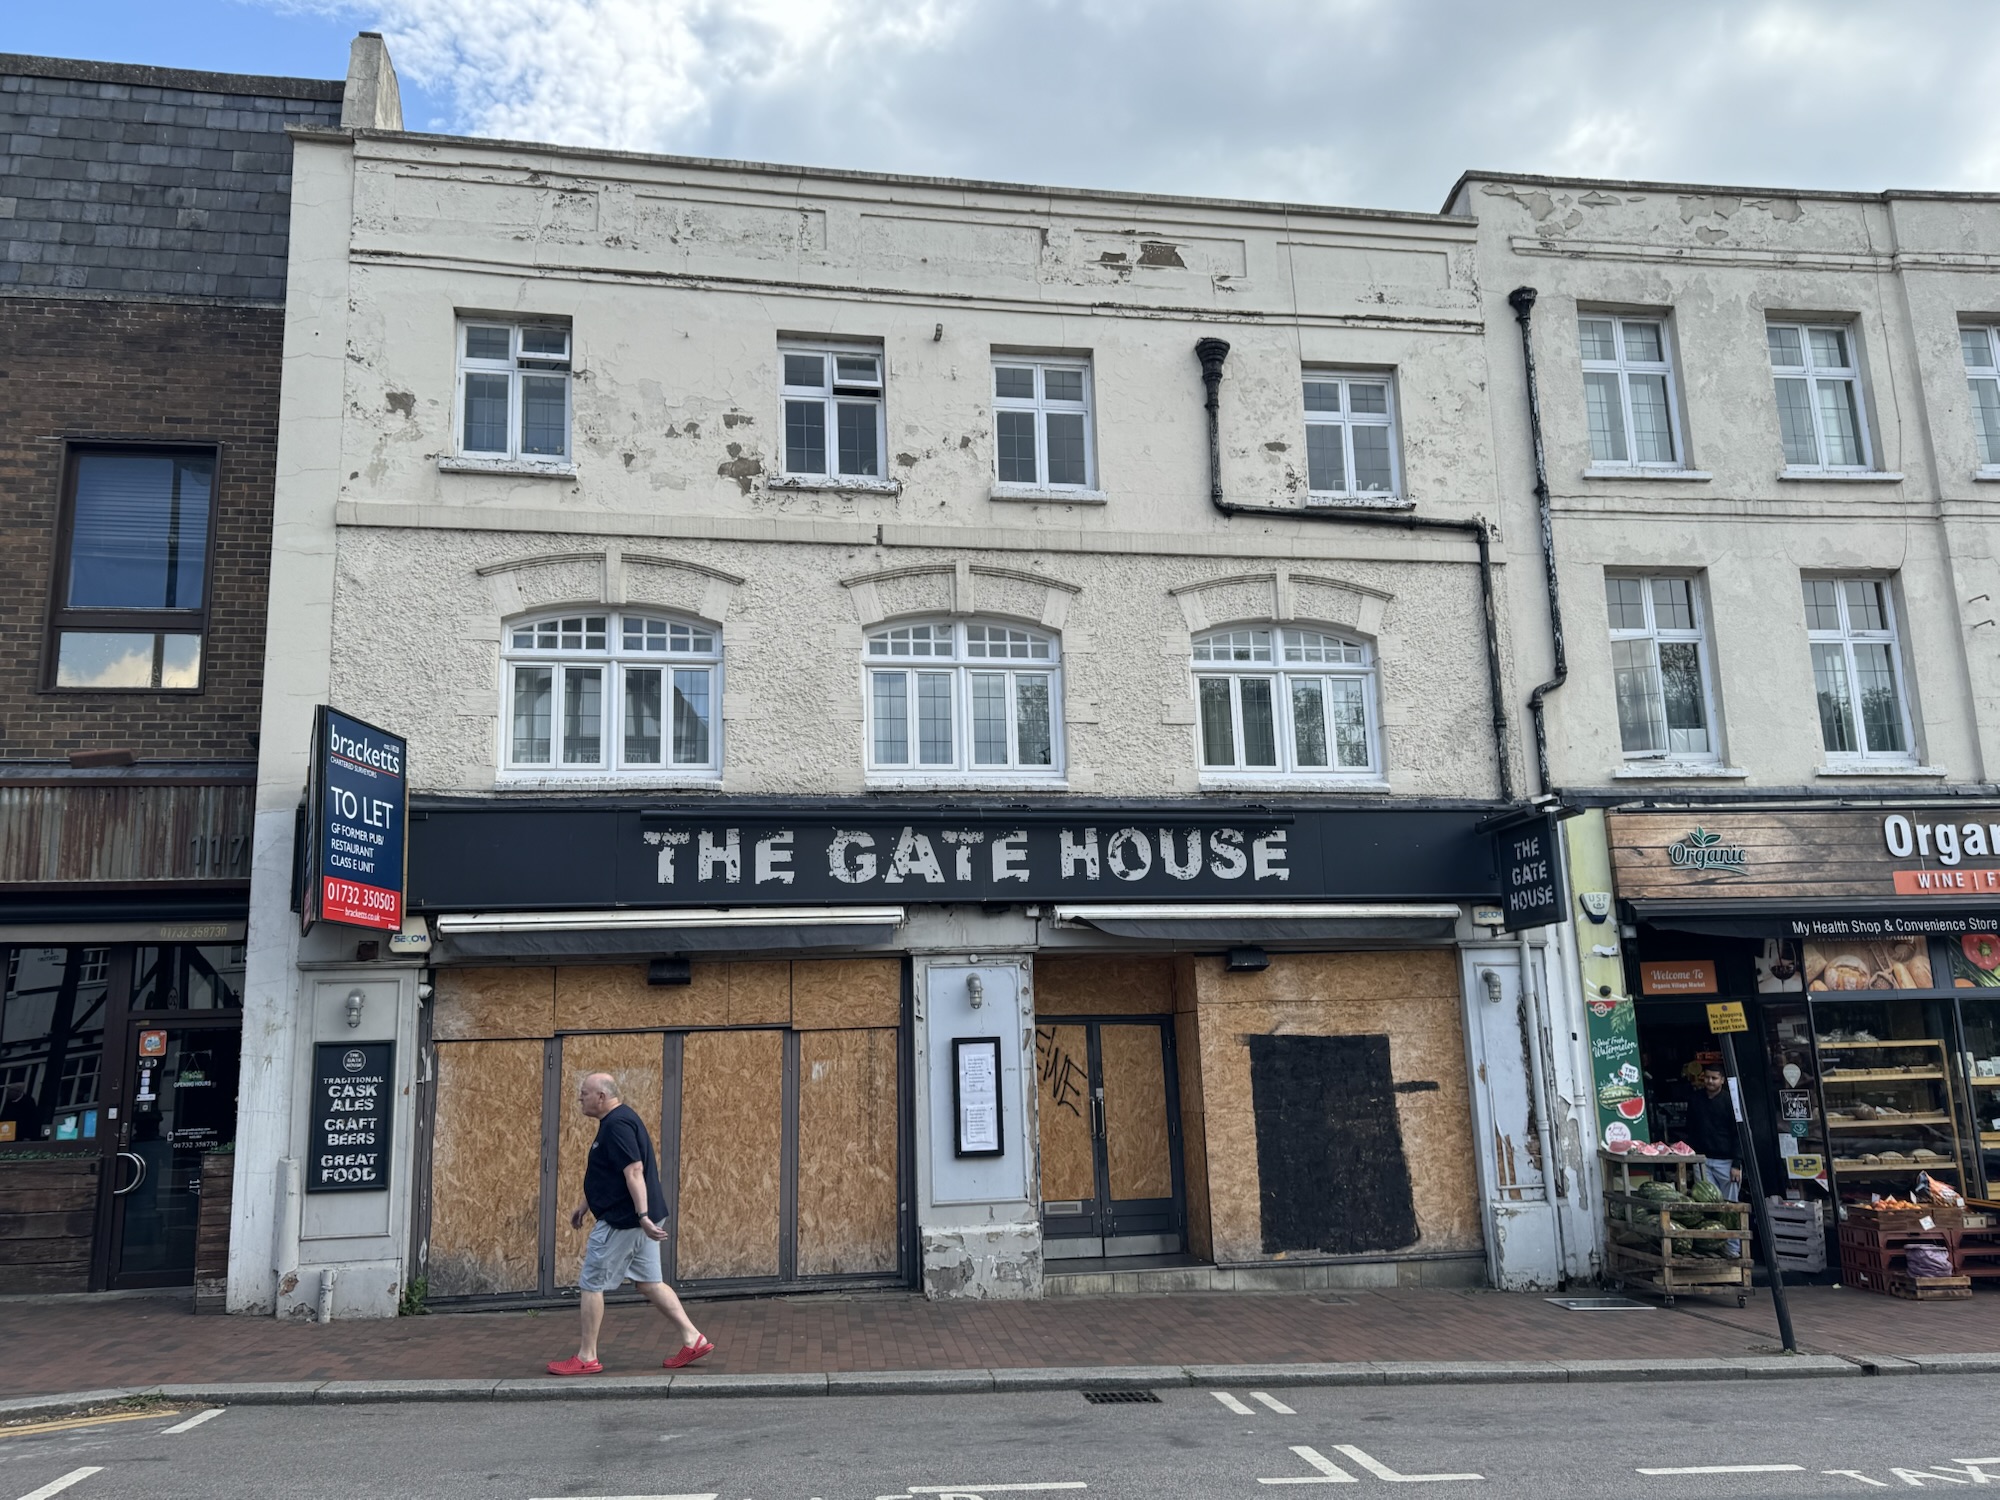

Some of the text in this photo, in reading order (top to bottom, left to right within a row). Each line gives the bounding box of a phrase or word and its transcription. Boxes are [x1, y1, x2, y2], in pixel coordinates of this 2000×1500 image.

[331, 724, 399, 774] bracketts
[331, 786, 394, 830] TO LET
[331, 822, 385, 846] GF FORMER PUB/
[192, 834, 246, 866] 117
[331, 838, 375, 859] RESTAURANT
[643, 826, 1291, 885] THE GATE HOUSE
[1514, 837, 1540, 860] THE
[1668, 843, 1747, 870] Organic
[331, 854, 375, 874] CLASS E UNIT
[1512, 860, 1548, 886] GATE
[1917, 872, 1966, 889] WINE
[327, 882, 396, 912] 01732 350503
[1509, 885, 1554, 911] HOUSE
[1588, 894, 1608, 903] USF
[344, 907, 381, 922] bracketts.co.uk
[1478, 911, 1503, 919] SECOM
[160, 926, 228, 939] 01732 358730
[1792, 916, 1998, 936] My Health Shop & Convenience Store
[394, 934, 426, 943] SECOM
[1651, 968, 1704, 980] Welcome To
[1652, 982, 1671, 990] Organic
[1593, 1040, 1637, 1058] Watermelon
[323, 1076, 384, 1085] TRADITIONAL
[328, 1084, 378, 1098] CASK
[330, 1098, 374, 1112] ALES
[324, 1117, 378, 1131] CRAFT
[327, 1133, 375, 1146] BEERS
[320, 1154, 378, 1168] GREAT
[321, 1167, 377, 1184] FOOD
